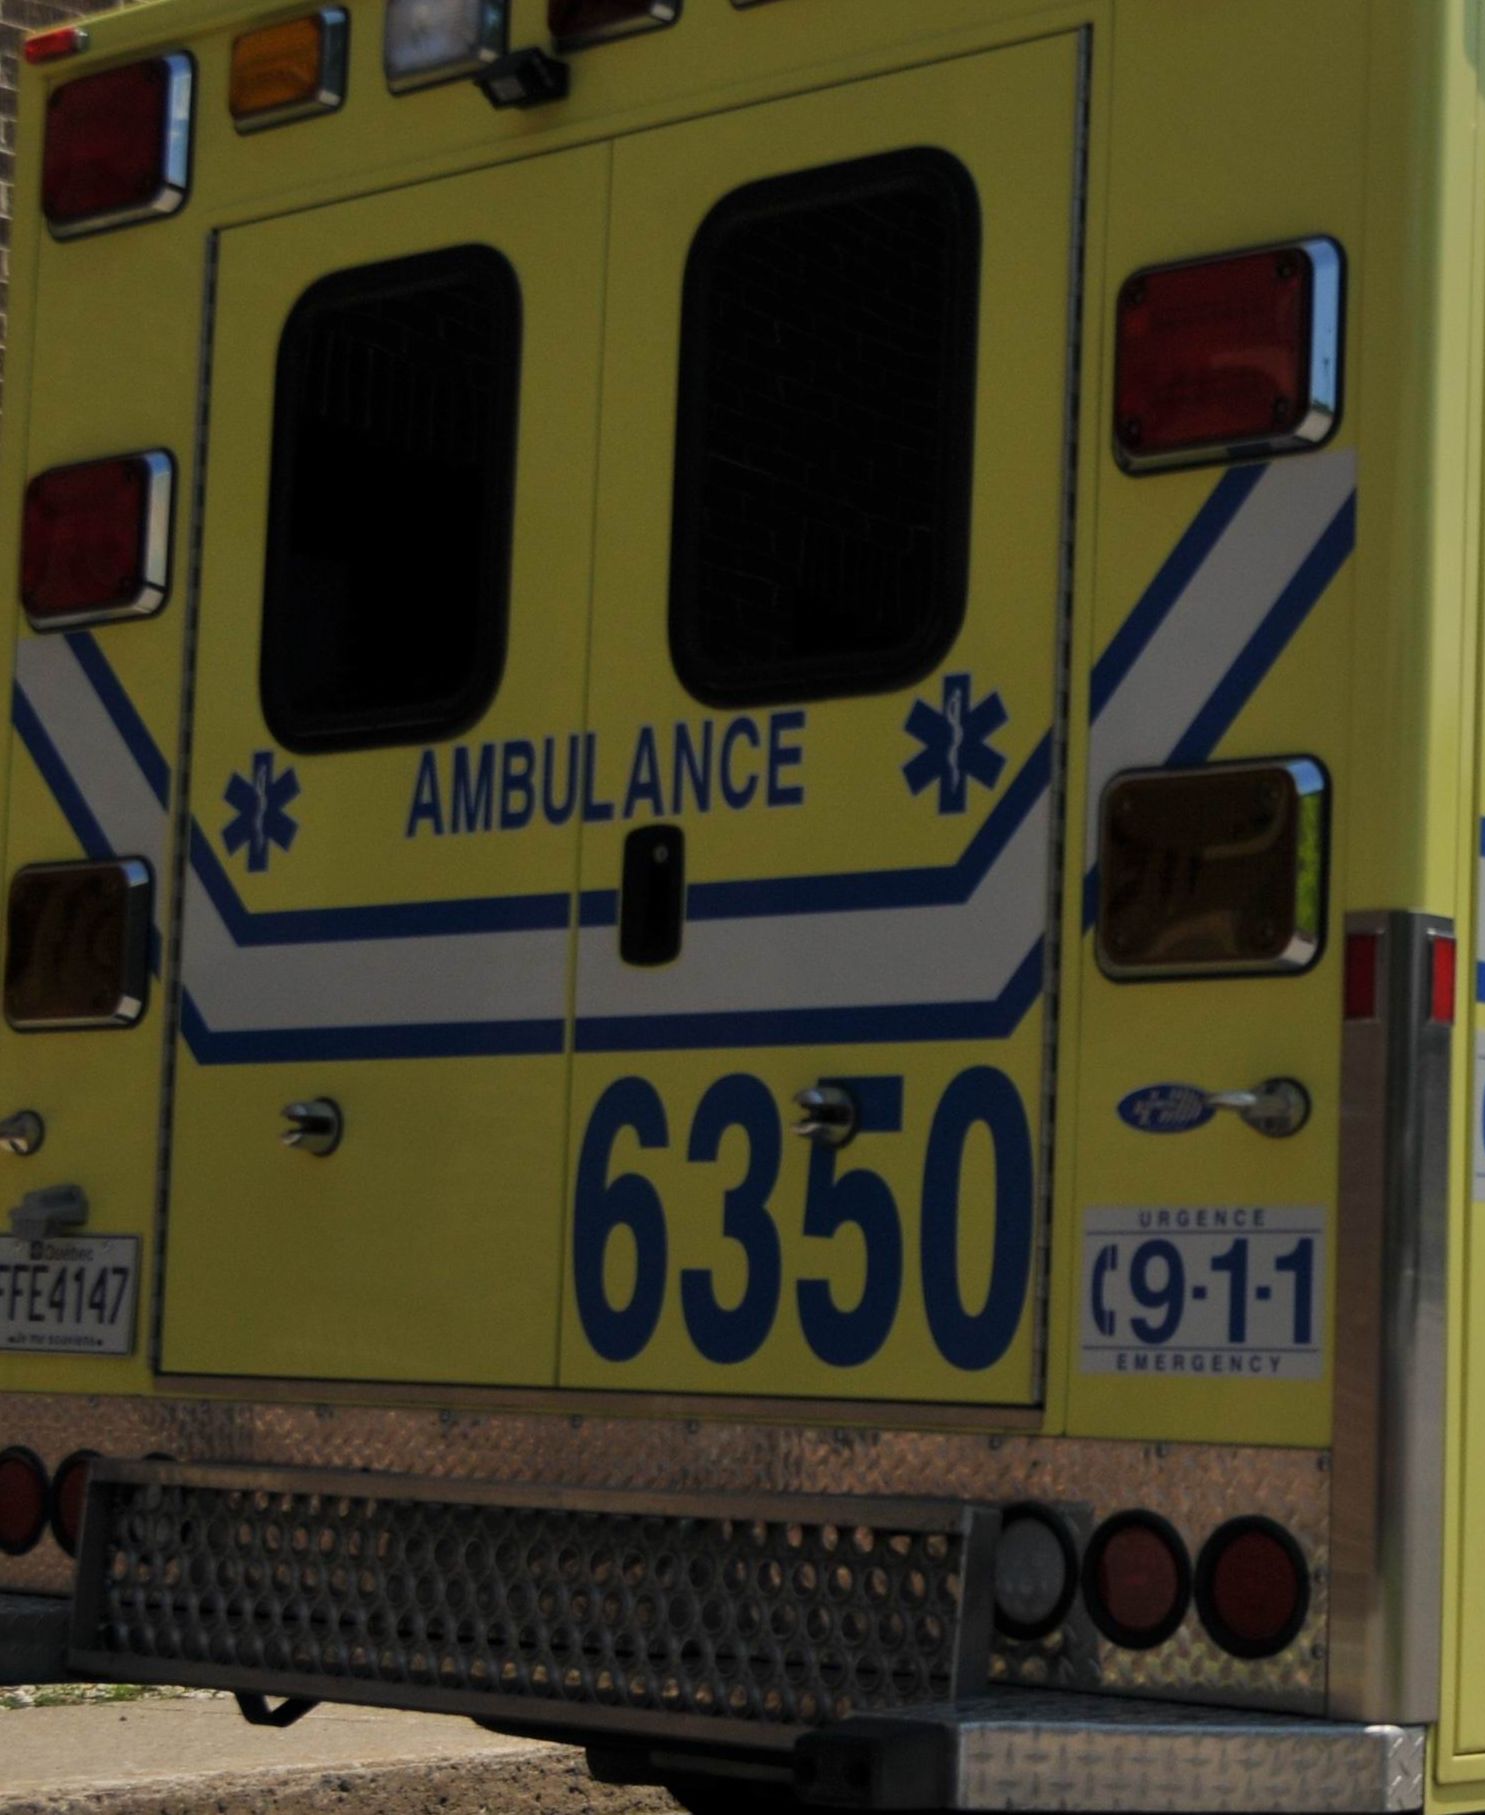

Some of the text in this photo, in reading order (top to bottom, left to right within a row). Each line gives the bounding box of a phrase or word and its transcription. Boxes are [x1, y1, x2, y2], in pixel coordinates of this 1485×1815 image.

[406, 710, 806, 838] AMBULANCE
[573, 1064, 1034, 1372] 6350
[1139, 1209, 1266, 1228] URGENCE
[1129, 1237, 1315, 1345] 9-1-1
[1116, 1353, 1282, 1374] EMERGENCY
